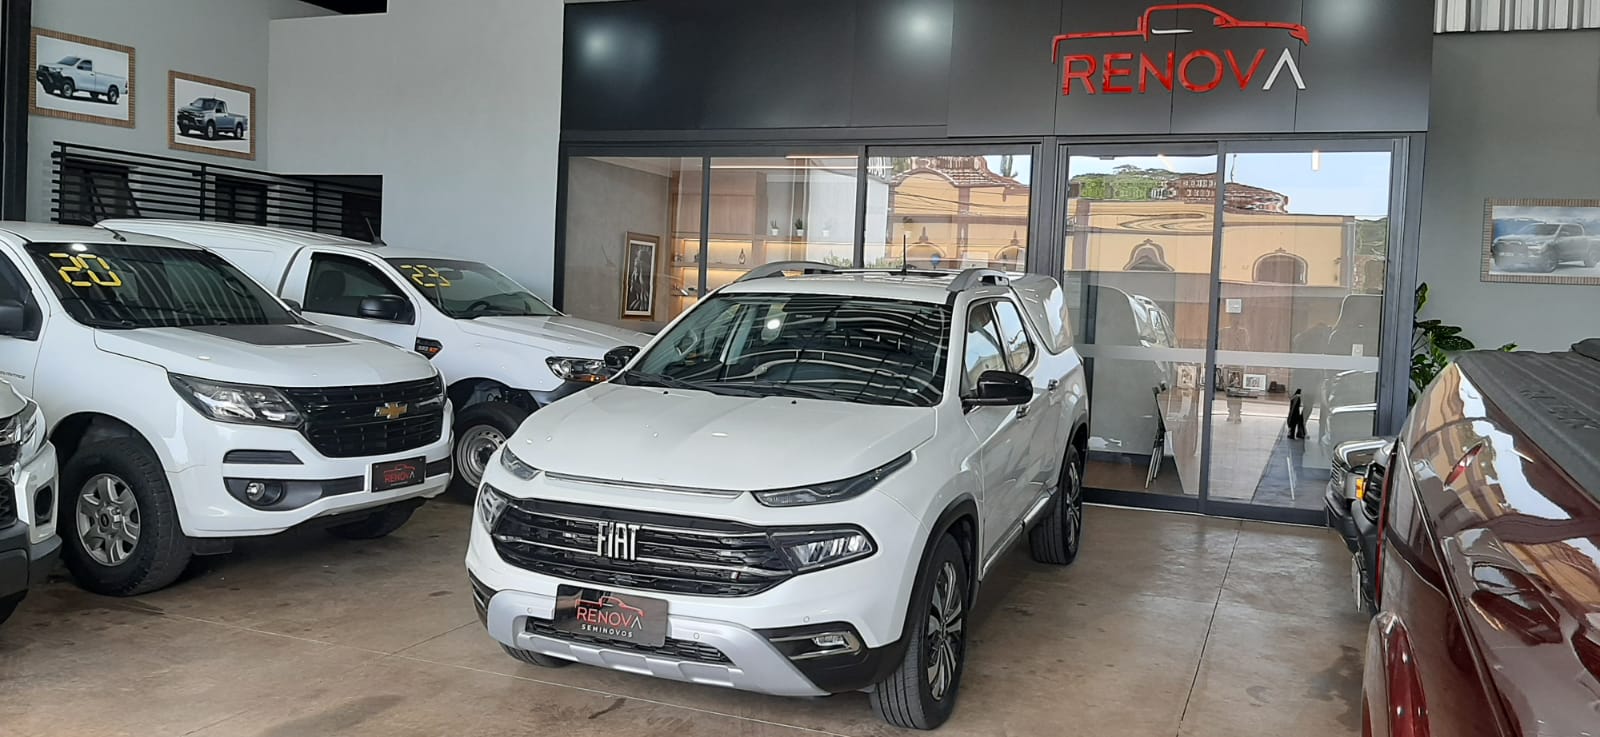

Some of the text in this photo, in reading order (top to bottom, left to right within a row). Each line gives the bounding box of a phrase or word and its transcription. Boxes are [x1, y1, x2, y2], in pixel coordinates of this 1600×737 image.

[1062, 48, 1306, 96] RENOVA
[49, 252, 122, 287] 20
[400, 264, 451, 287] 23
[384, 471, 415, 484] RENOVA
[597, 521, 640, 561] FIAT
[576, 606, 642, 630] RENOVA
[581, 623, 633, 638] SEMINOVOS
